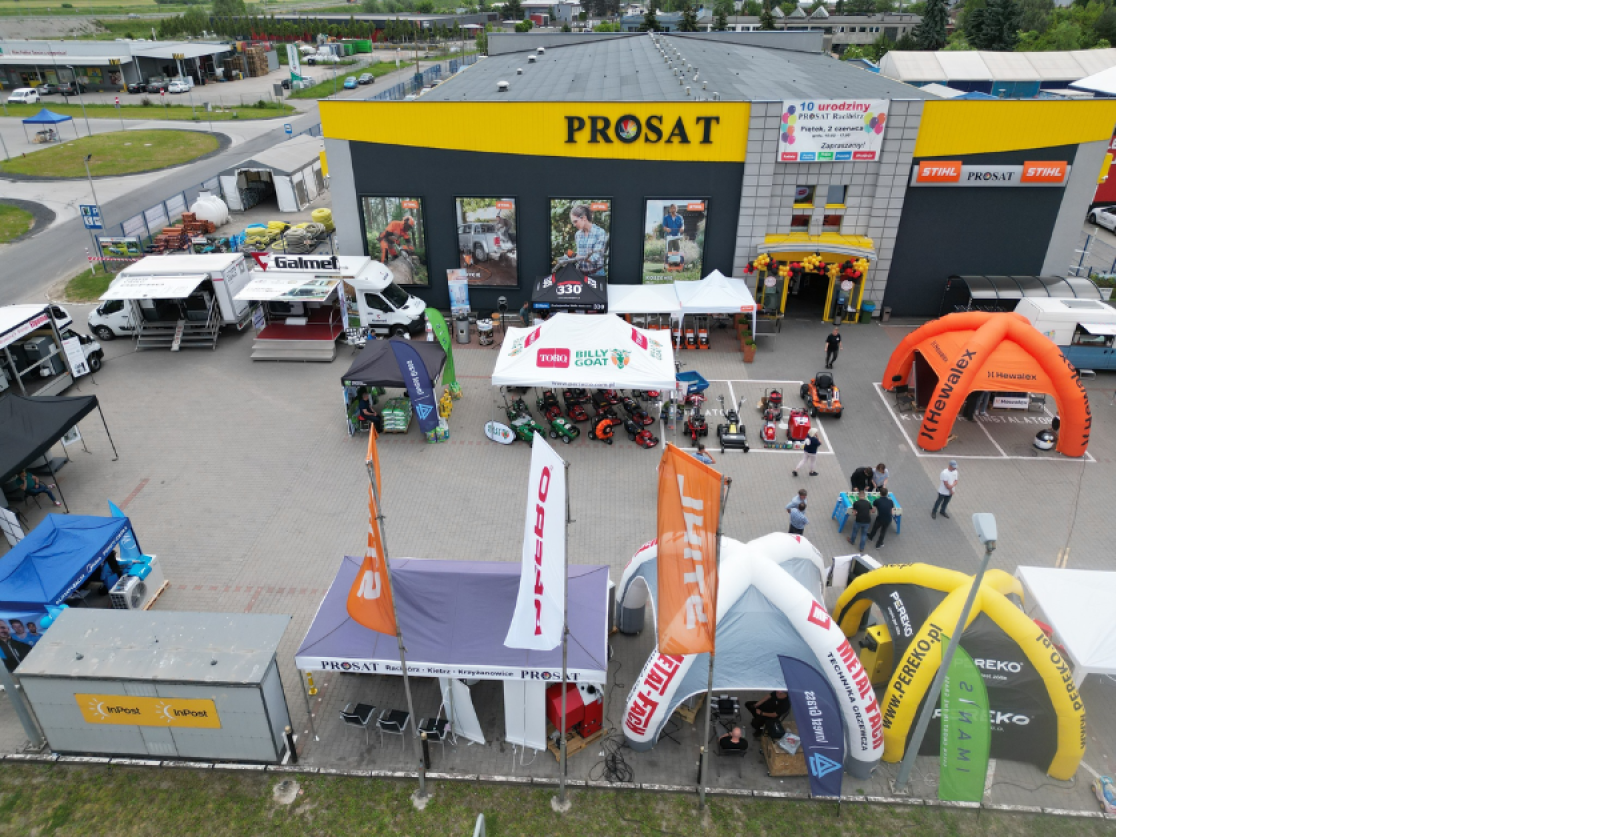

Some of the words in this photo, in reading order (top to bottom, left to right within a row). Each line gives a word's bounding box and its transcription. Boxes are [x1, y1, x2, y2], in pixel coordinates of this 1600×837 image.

[800, 101, 815, 111] 10
[818, 101, 871, 113] urodziny
[798, 112, 830, 120] PROSAT
[564, 114, 720, 144] PROSAT
[921, 167, 957, 177] STIHL
[967, 171, 1015, 181] PROSAT
[1025, 167, 1062, 177] STIHL
[274, 256, 338, 269] Galmet
[556, 284, 582, 295] 330
[575, 349, 609, 358] BILLY
[574, 358, 609, 367] GOAT
[996, 371, 1037, 381] Hewalex
[926, 348, 977, 421] Hewalex
[889, 590, 913, 637] PEREKO
[321, 661, 379, 671] PROSAT
[827, 651, 858, 704] TECHNIKA
[882, 623, 943, 729] www.PEREKO.pl
[836, 637, 885, 751] METAL-FACH
[106, 706, 141, 715] InPost
[173, 709, 208, 718] InPost
